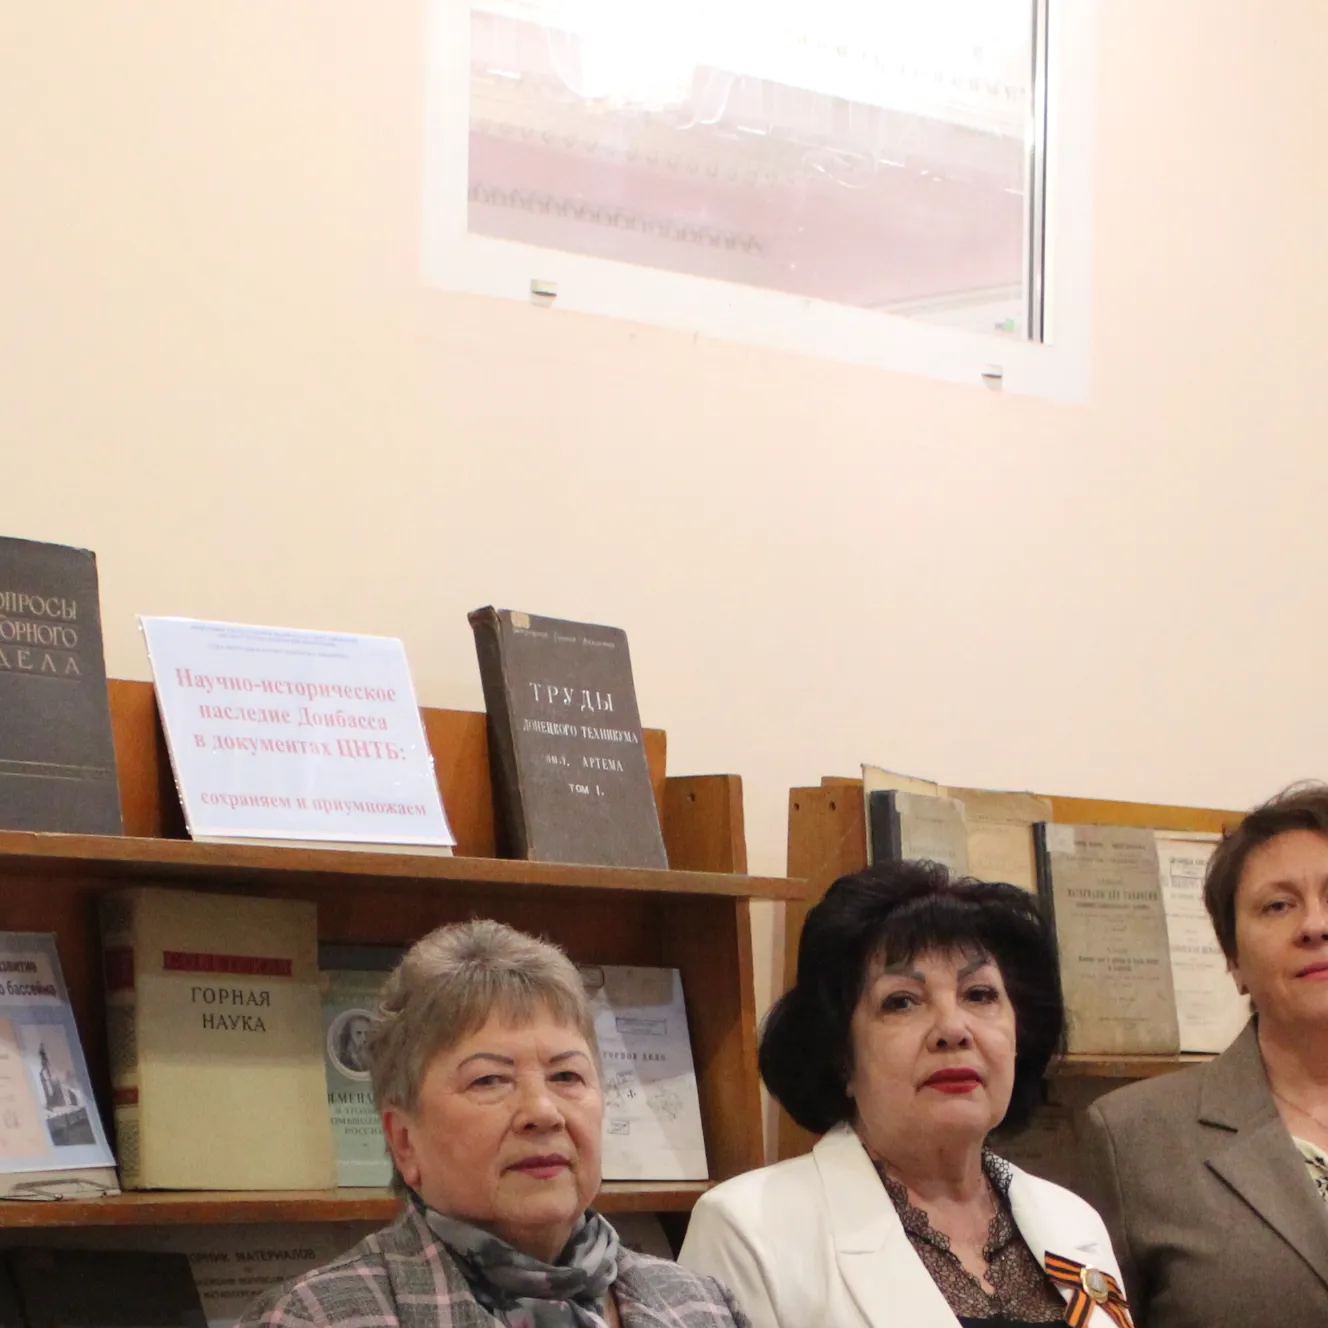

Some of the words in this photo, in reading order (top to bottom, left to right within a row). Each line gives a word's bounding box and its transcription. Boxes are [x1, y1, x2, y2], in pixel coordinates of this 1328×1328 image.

[175, 668, 396, 702] Научно-историческое
[529, 682, 614, 713] ТРУДЫ
[199, 704, 291, 724] наследие
[297, 707, 388, 731] Донбасса
[523, 719, 578, 737] ДОНЕЦКОГО
[580, 726, 639, 744] ТЕХНИКУМА
[193, 734, 206, 748] в
[212, 735, 332, 756] документах
[335, 738, 407, 761] ЦНТБ:
[582, 756, 624, 772] АРТЕМА
[201, 792, 291, 810] сохраняем
[296, 797, 307, 809] и
[312, 797, 427, 816] приумножаем
[6, 980, 58, 997] бассейна
[191, 986, 271, 1007] ГОРНАЯ
[202, 1013, 267, 1032] НАУКА
